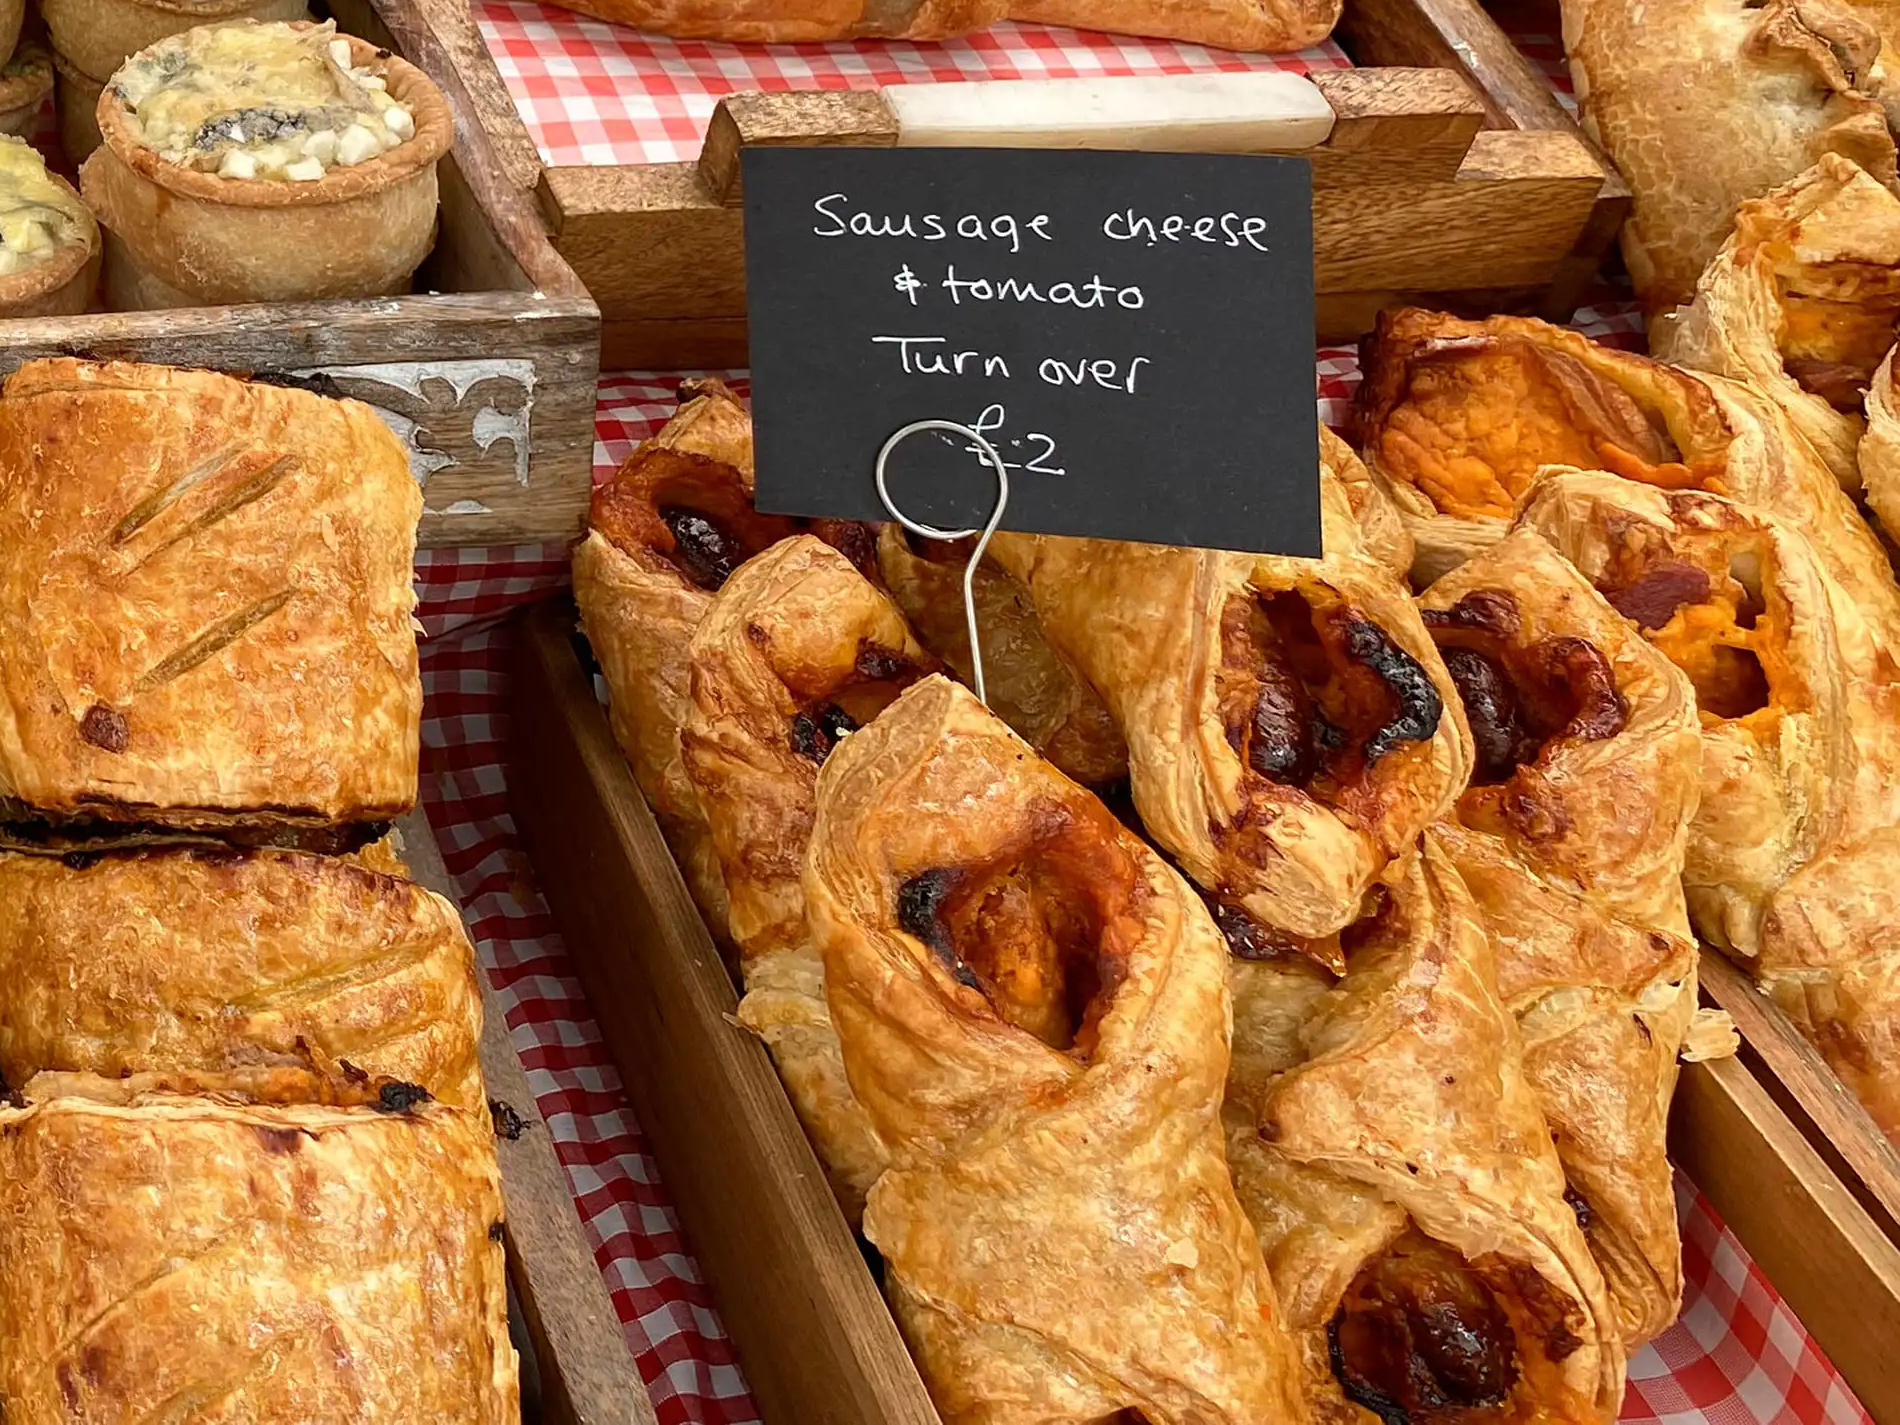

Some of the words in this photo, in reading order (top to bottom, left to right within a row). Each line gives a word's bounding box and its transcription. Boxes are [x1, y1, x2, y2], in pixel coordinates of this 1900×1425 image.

[812, 192, 1054, 253] Sausage
[1102, 206, 1270, 253] cheese
[942, 263, 1145, 309] tomato
[870, 335, 1011, 379] Turn
[1039, 354, 1152, 395] over
